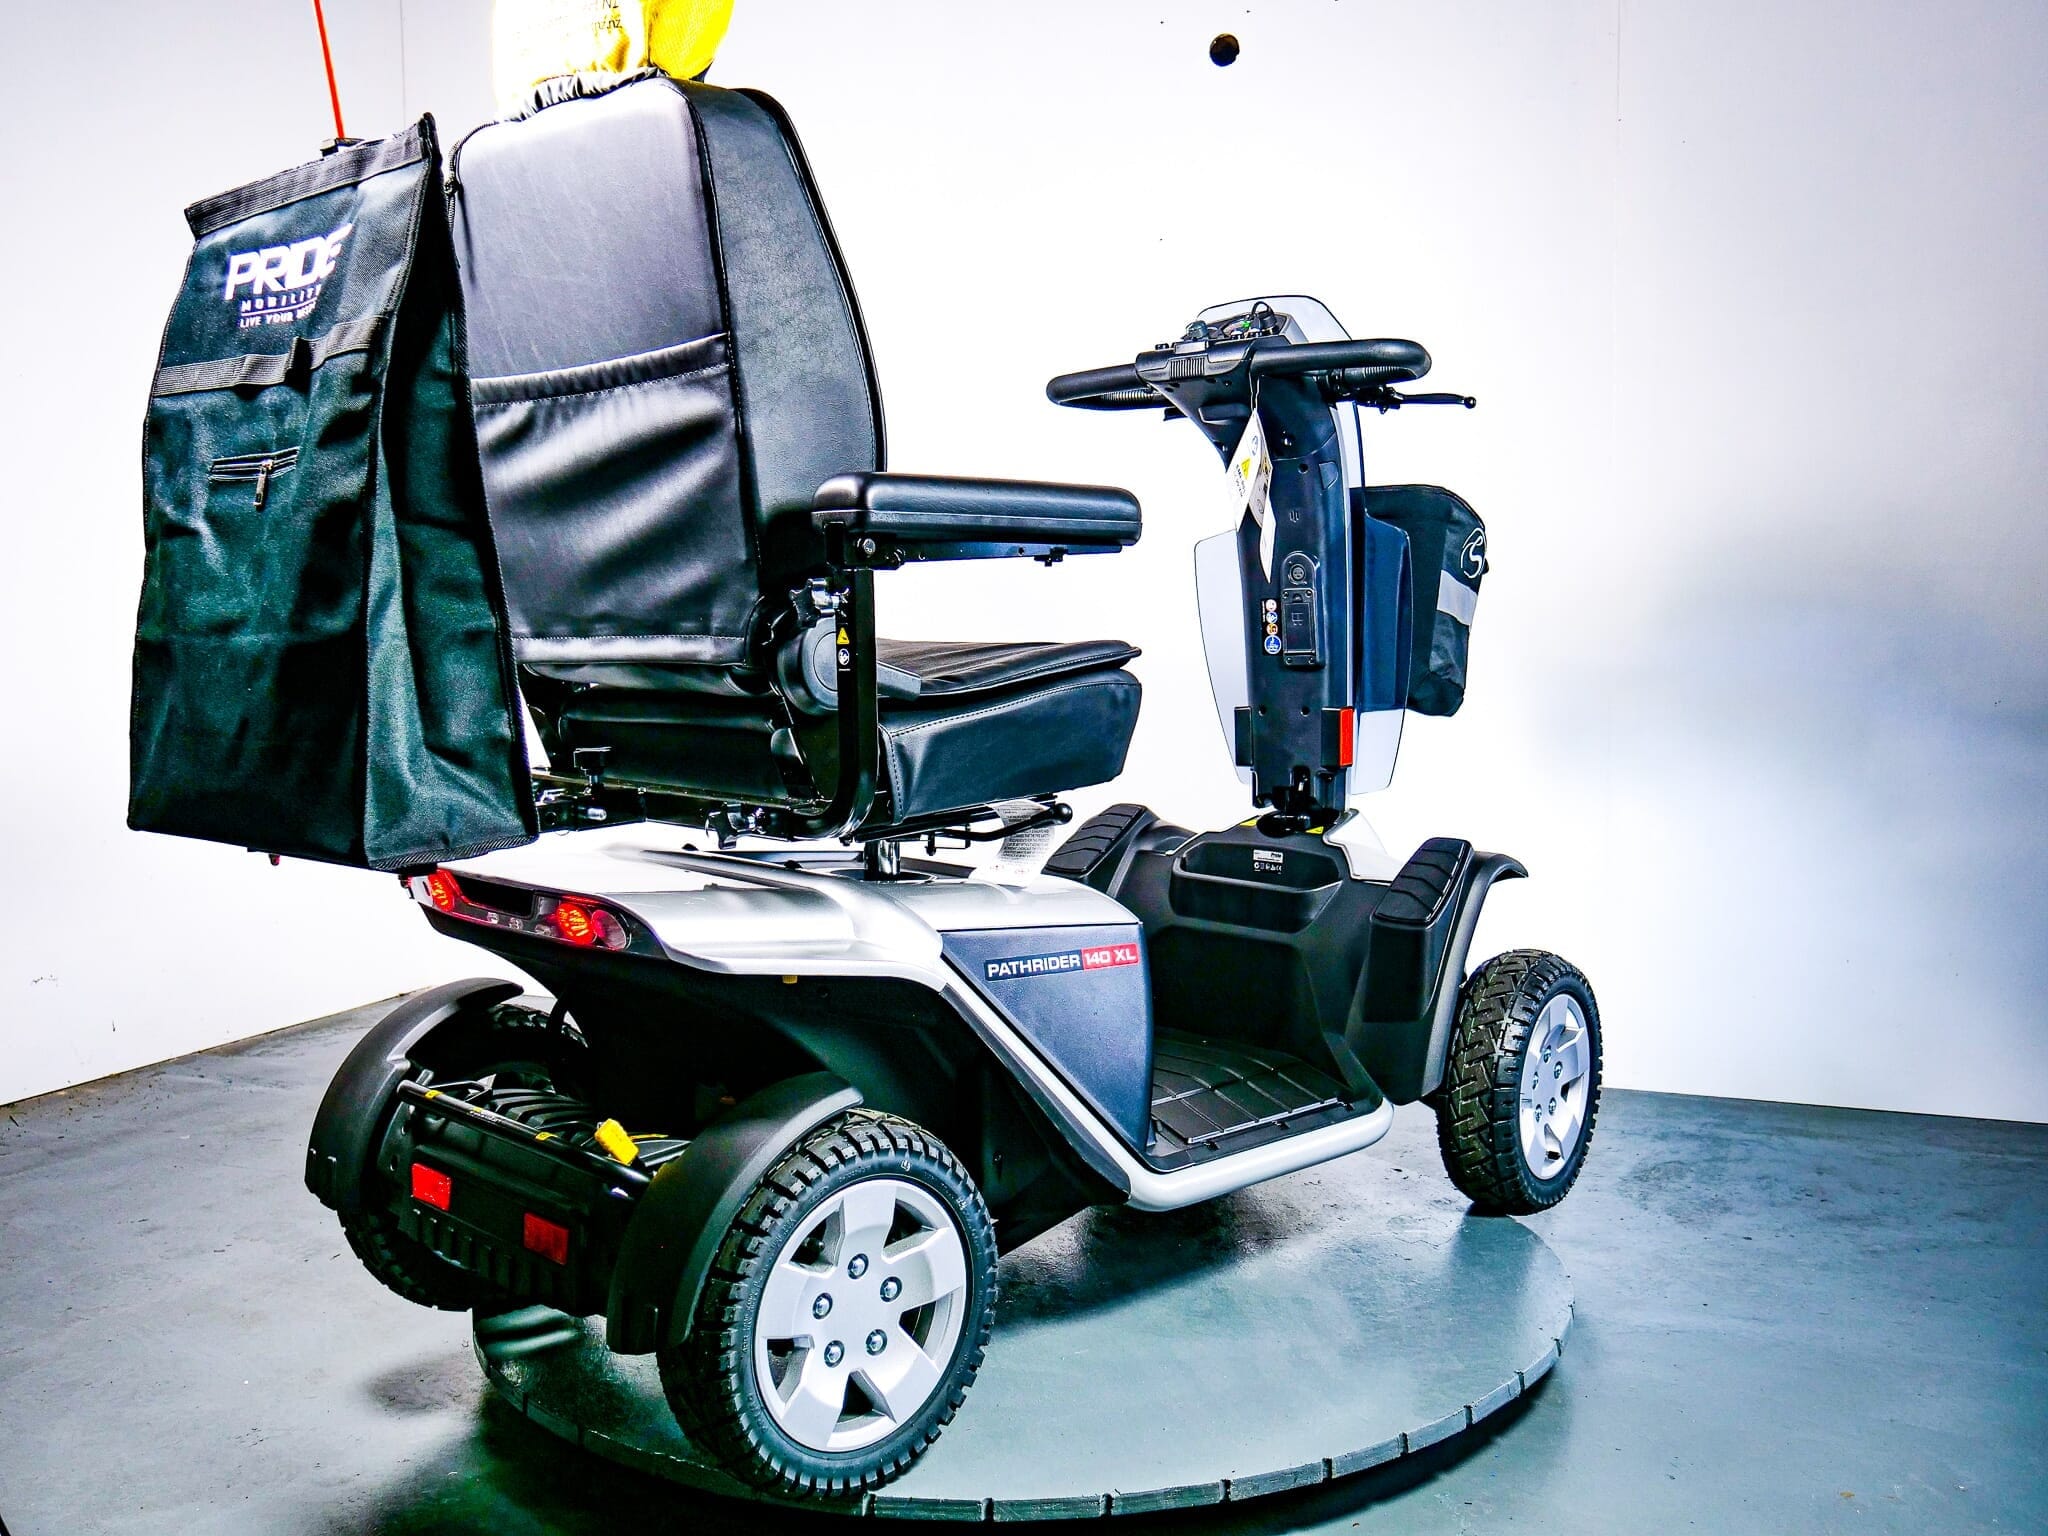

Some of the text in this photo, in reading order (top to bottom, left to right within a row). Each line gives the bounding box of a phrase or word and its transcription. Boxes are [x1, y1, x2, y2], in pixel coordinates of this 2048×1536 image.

[224, 222, 353, 300] PRIDE
[240, 316, 262, 328] LIVE
[265, 311, 294, 324] YOUR
[987, 948, 1137, 978] PATHRIDER 140 XL
